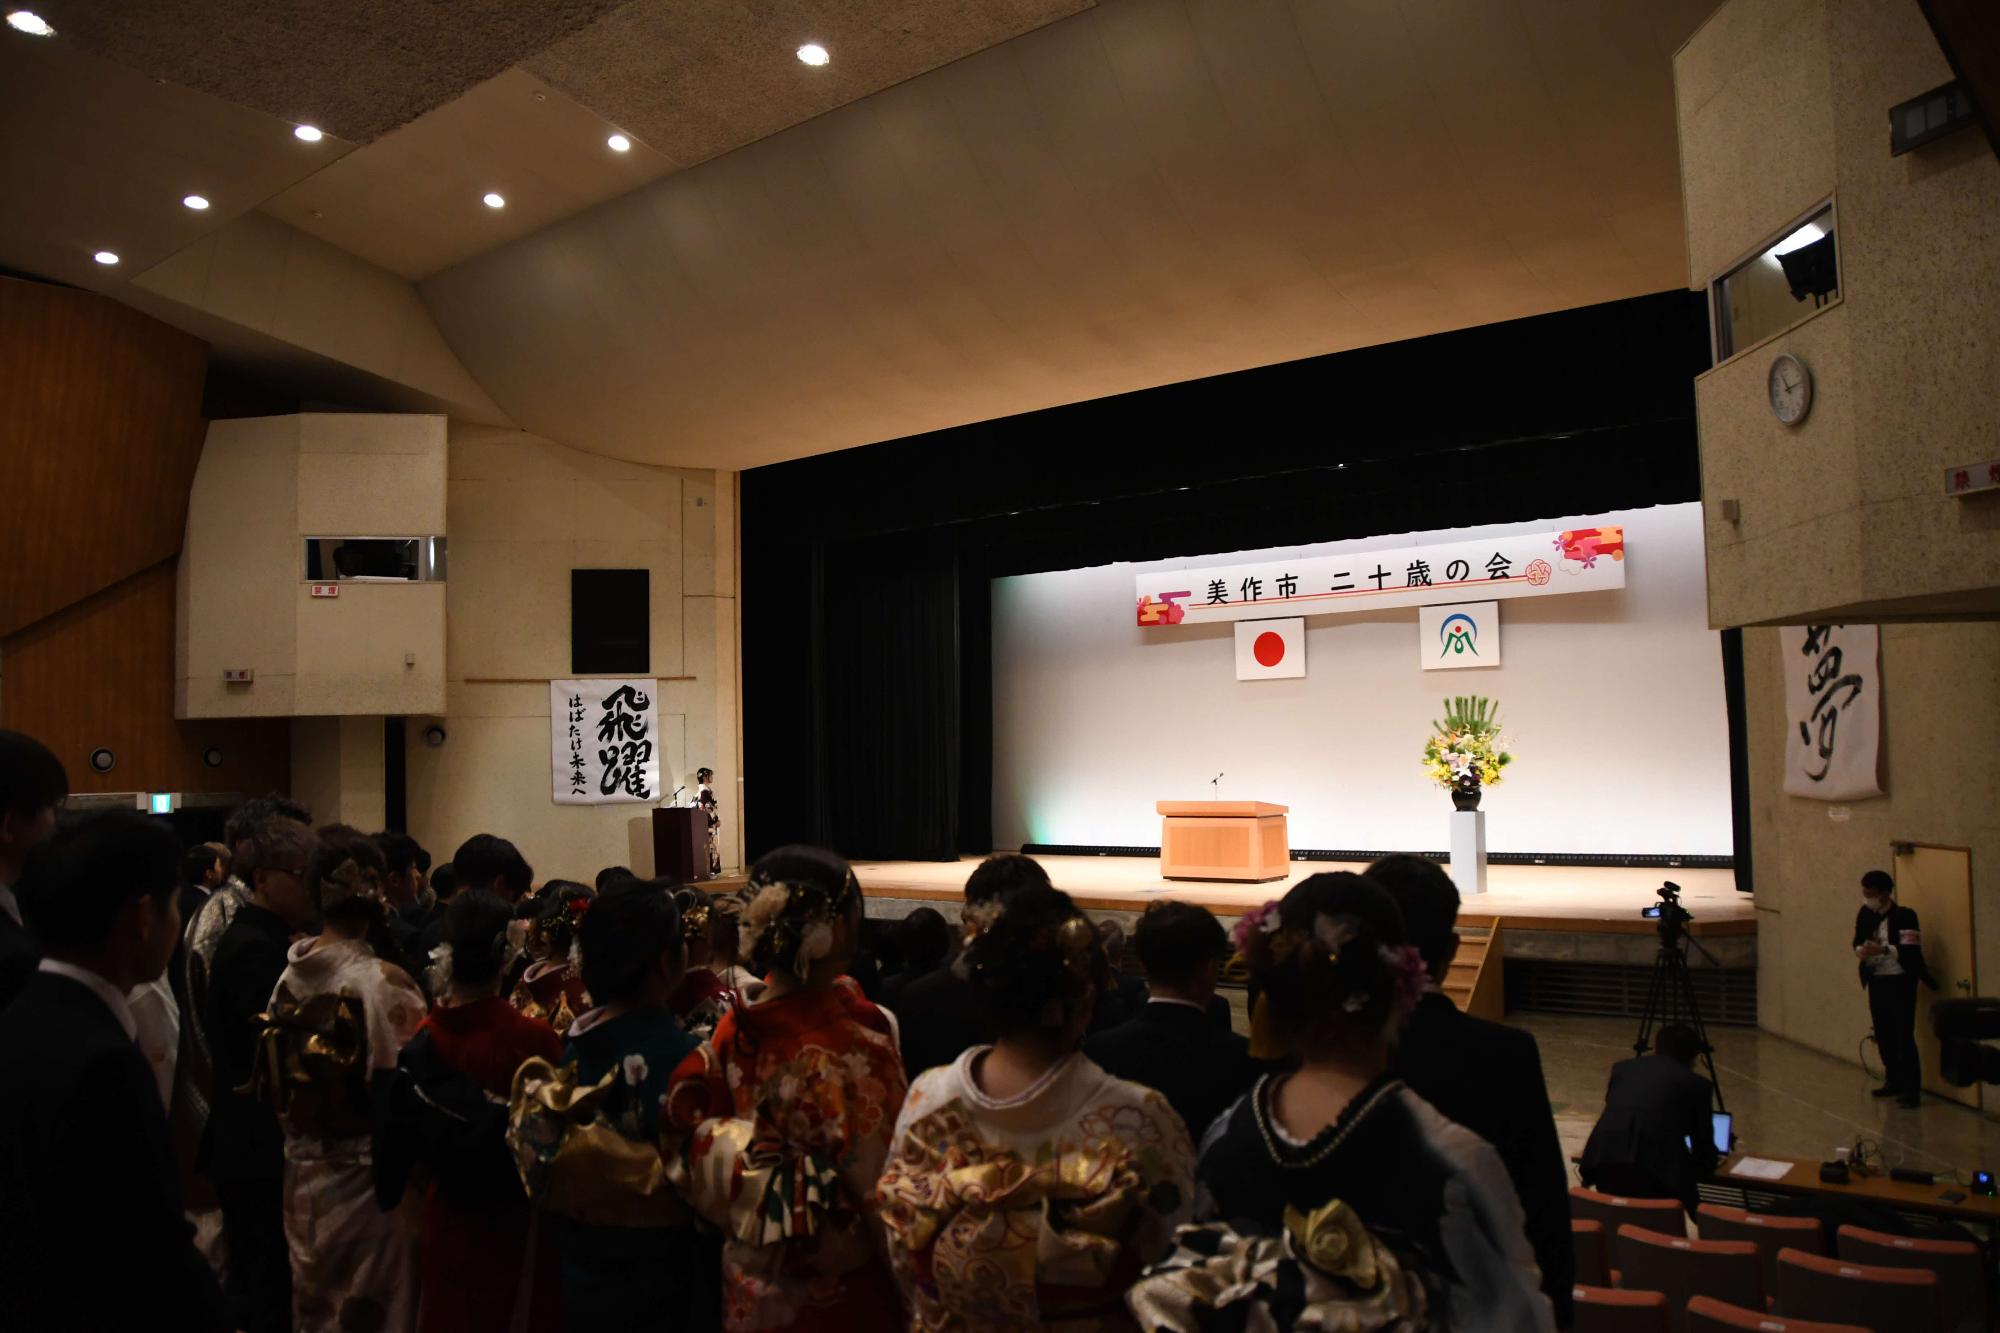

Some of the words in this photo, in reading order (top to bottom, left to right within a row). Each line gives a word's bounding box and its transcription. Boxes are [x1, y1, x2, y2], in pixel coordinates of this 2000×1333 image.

[1207, 573, 1300, 606] 美作市
[1331, 551, 1513, 592] 二十歳の会
[569, 693, 588, 796] はばたけ未来へ
[596, 684, 653, 800] 飛躍
